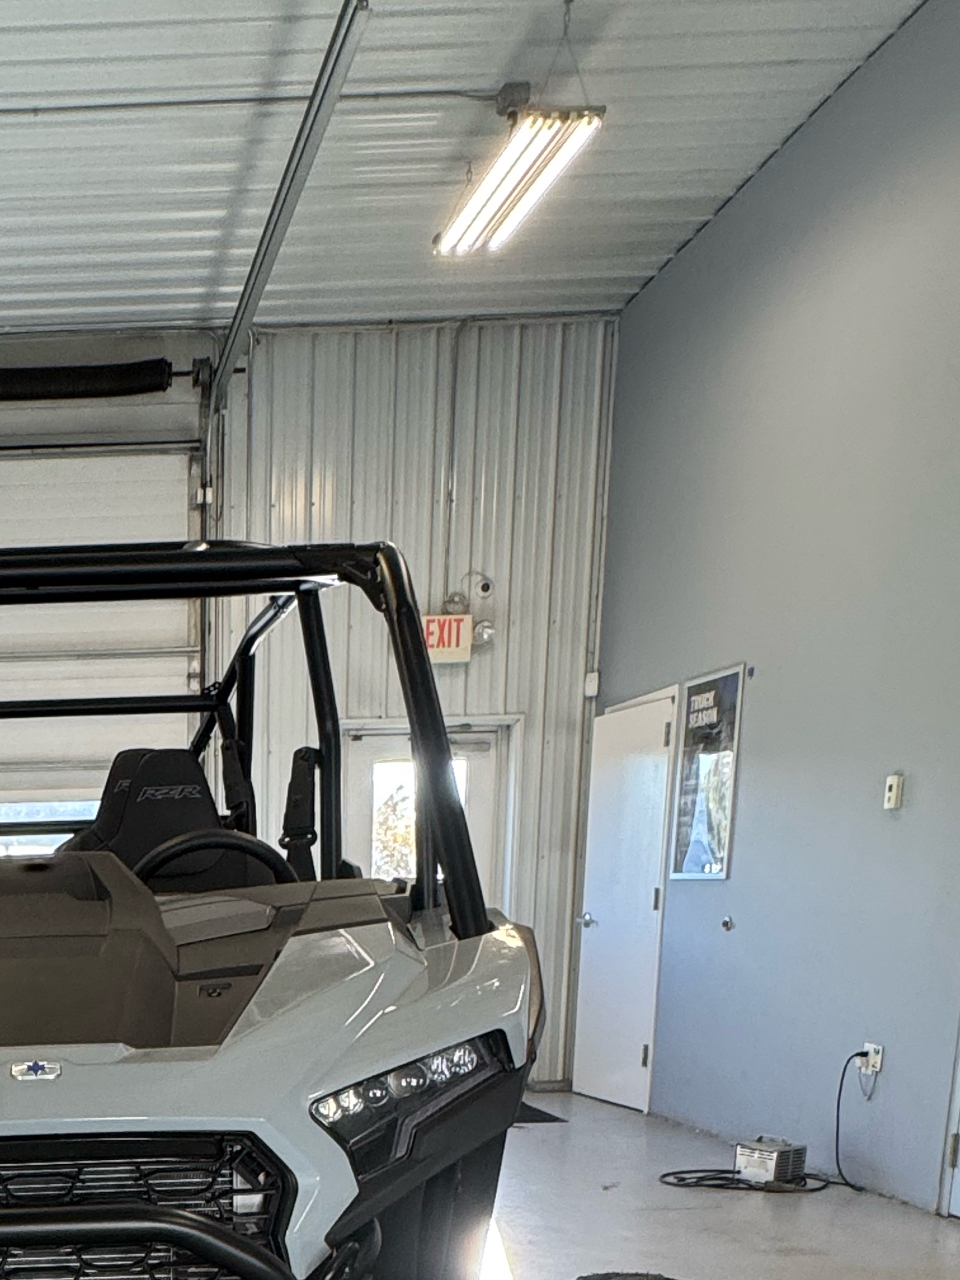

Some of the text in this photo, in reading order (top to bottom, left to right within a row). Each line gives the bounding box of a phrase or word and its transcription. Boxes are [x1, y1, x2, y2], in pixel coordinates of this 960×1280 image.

[426, 618, 464, 648] EXIT
[688, 707, 718, 728] SEASON
[136, 784, 202, 803] RZR
